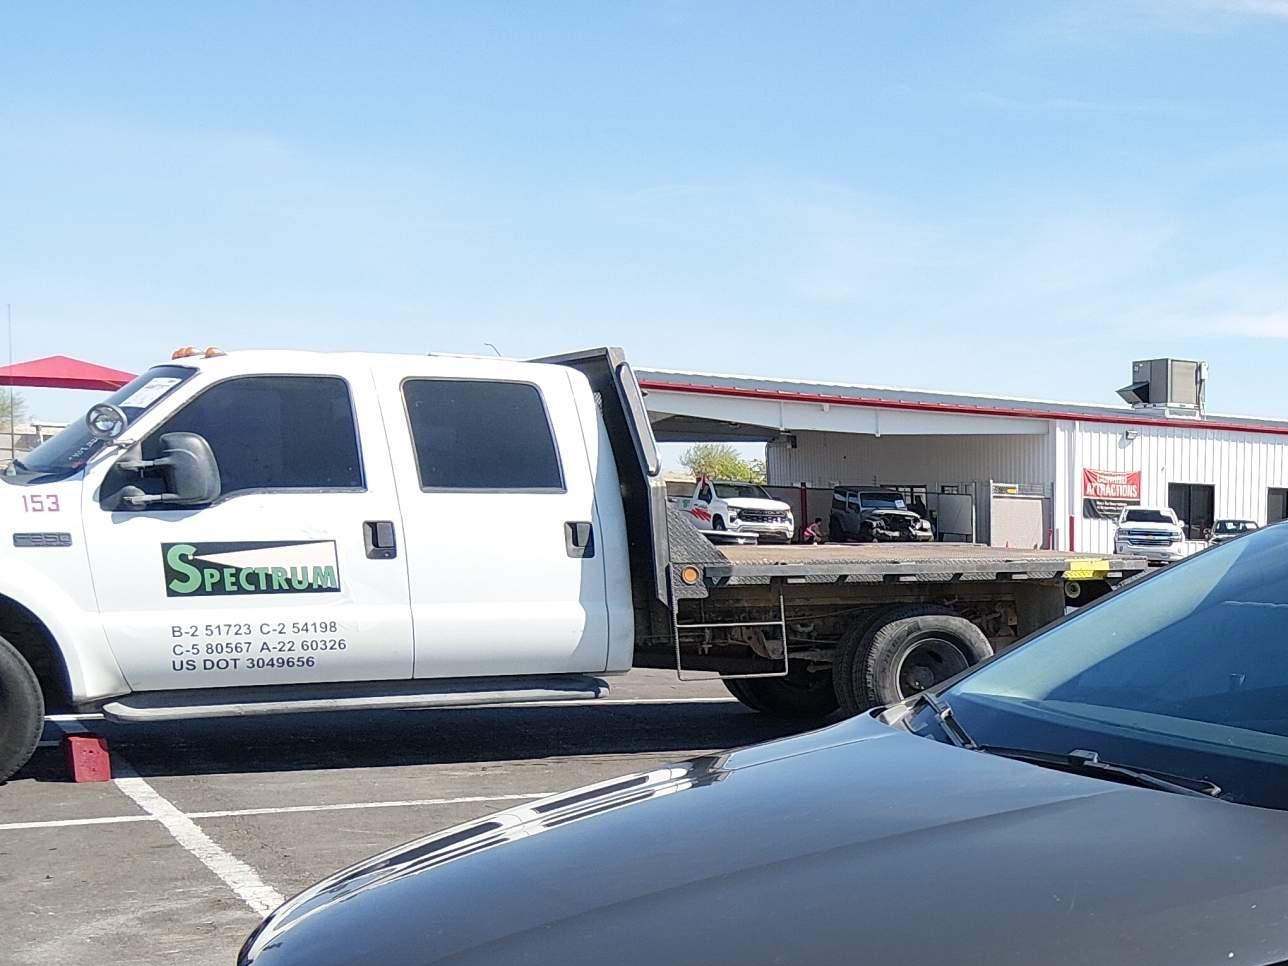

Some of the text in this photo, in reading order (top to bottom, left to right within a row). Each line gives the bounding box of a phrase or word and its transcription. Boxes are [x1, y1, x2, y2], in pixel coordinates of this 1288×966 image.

[1086, 483, 1137, 497] ATTRACTIONS
[22, 494, 60, 513] 153
[167, 544, 338, 593] SPECTRUM
[171, 621, 338, 638] B-2 51723 C-2 54198
[172, 638, 347, 656] C-5 80567 A-22 60326
[172, 656, 316, 671] US DOT 3049656
